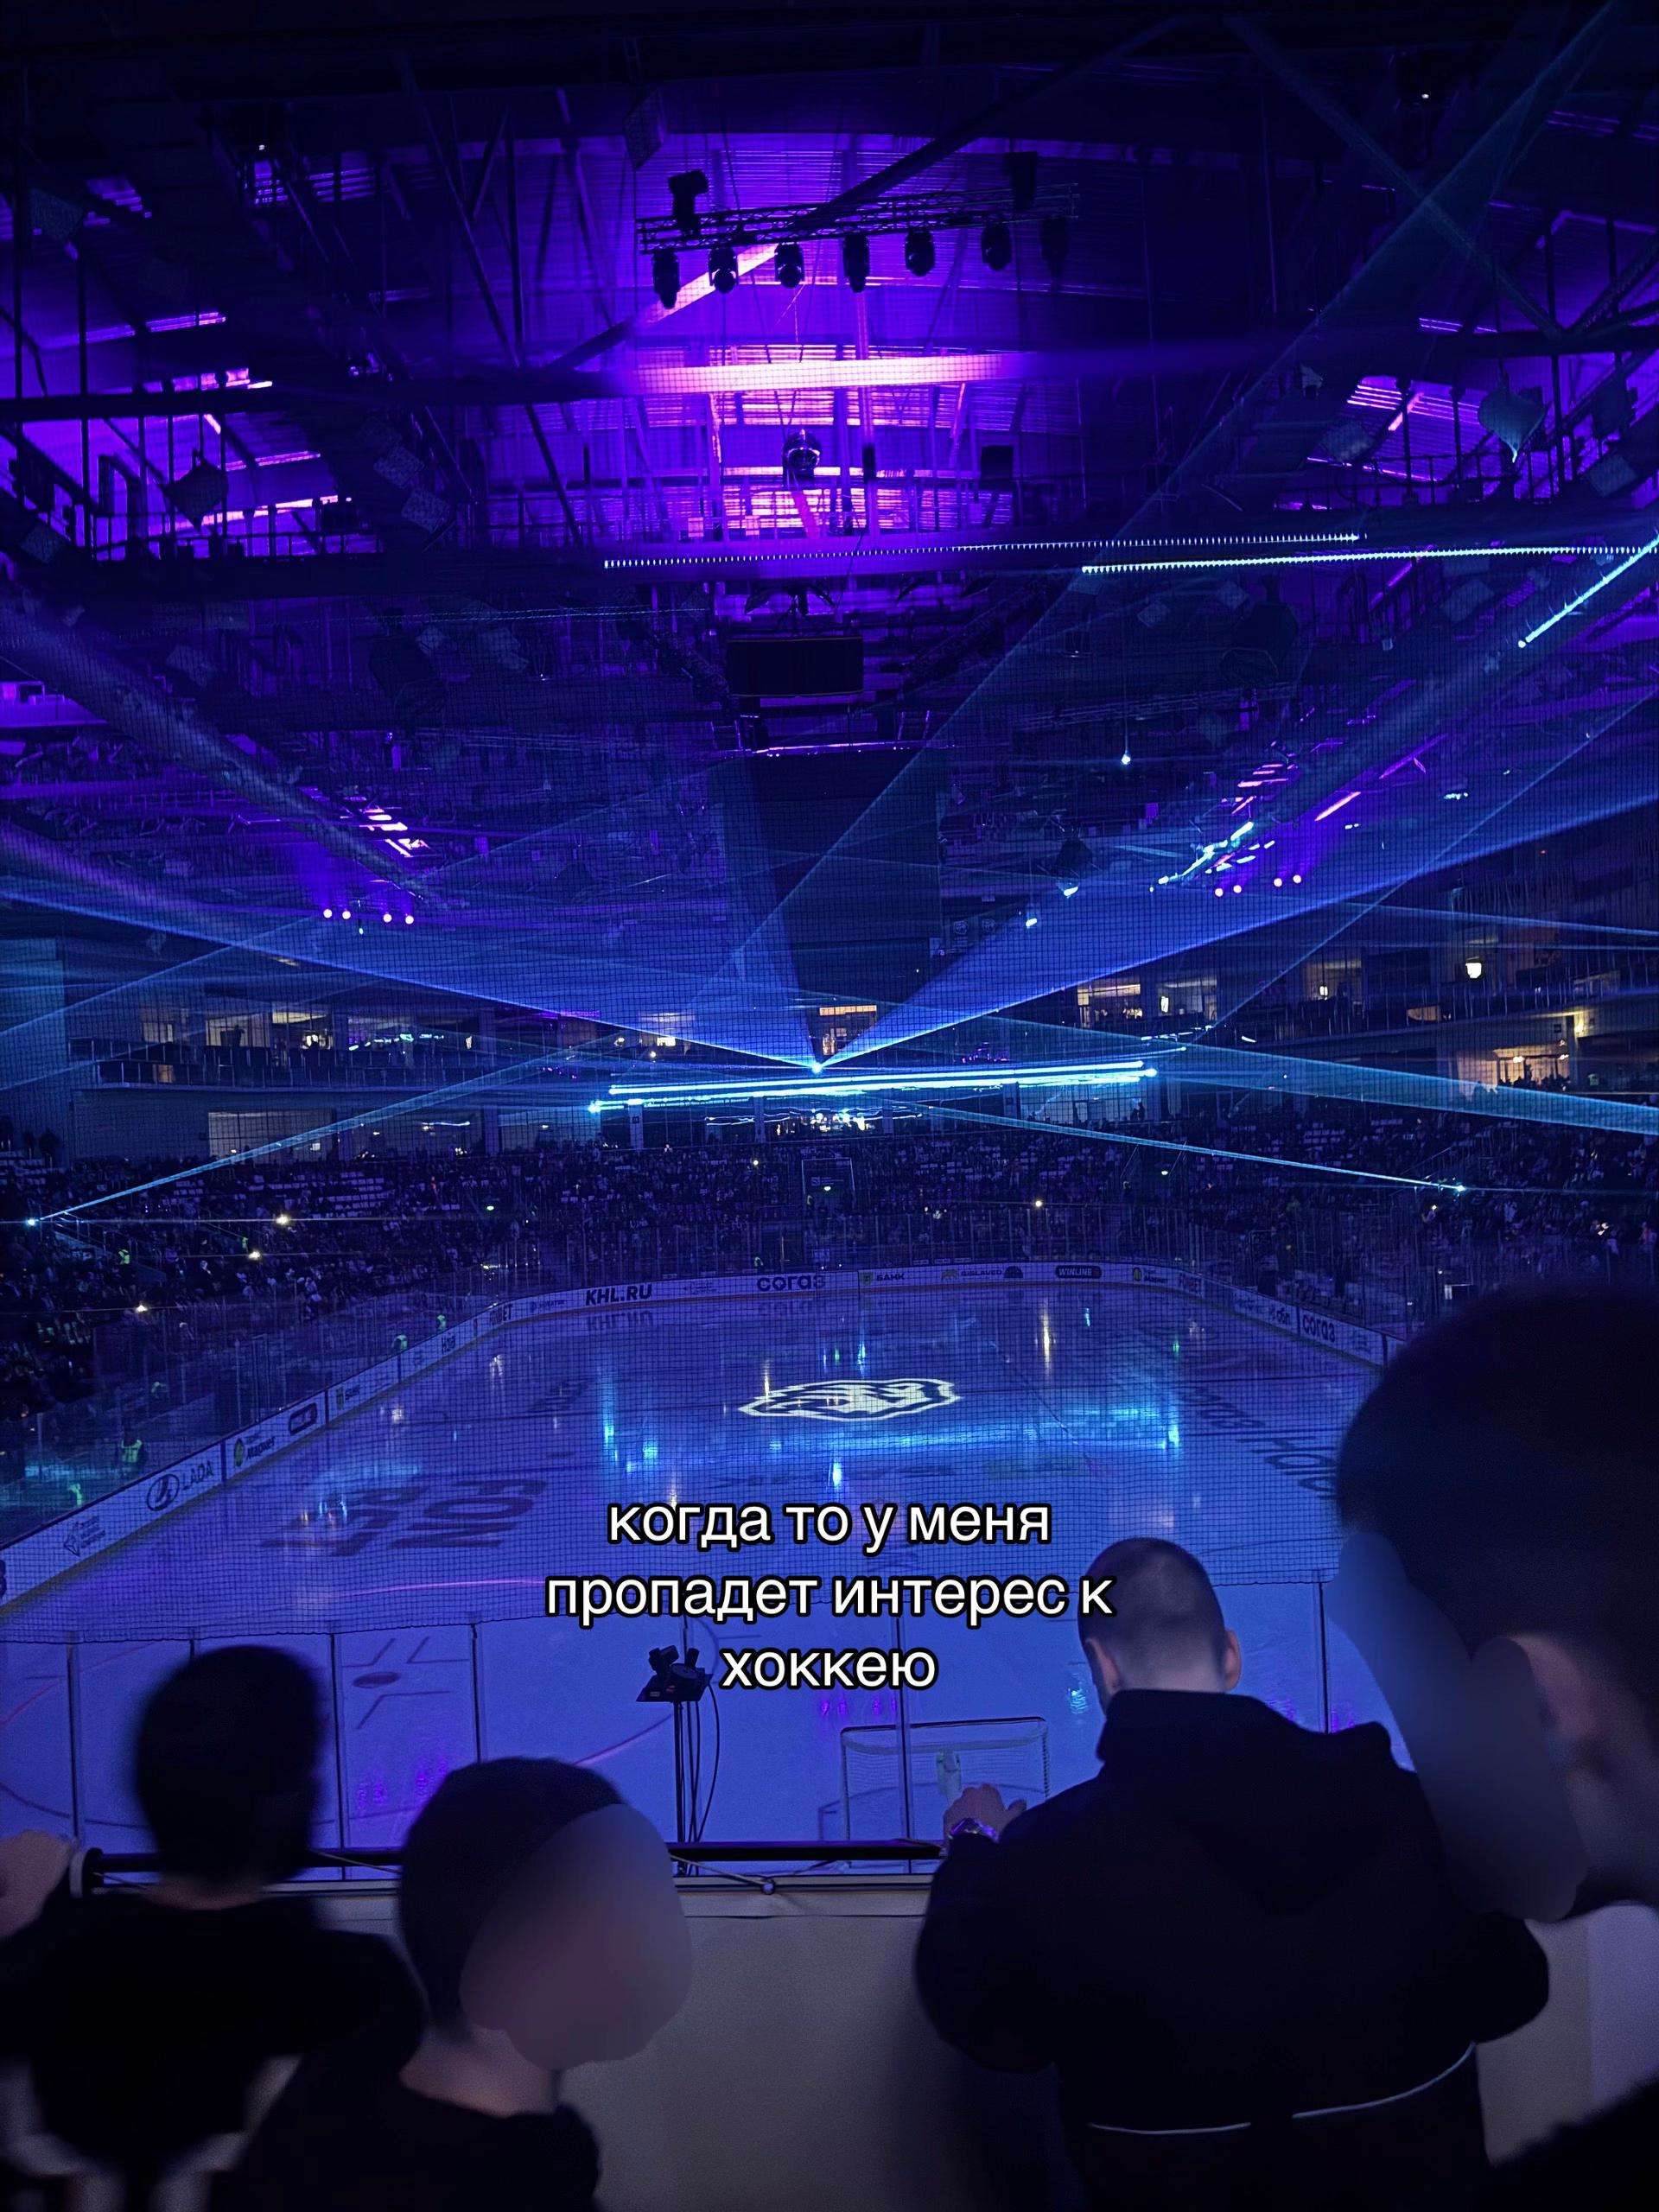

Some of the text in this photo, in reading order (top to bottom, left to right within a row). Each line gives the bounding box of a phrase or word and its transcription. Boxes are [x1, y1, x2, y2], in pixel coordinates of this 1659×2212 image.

[1058, 1268, 1092, 1276] WINLINE
[585, 1283, 652, 1306] KHL.RU
[181, 1461, 213, 1490] LADA
